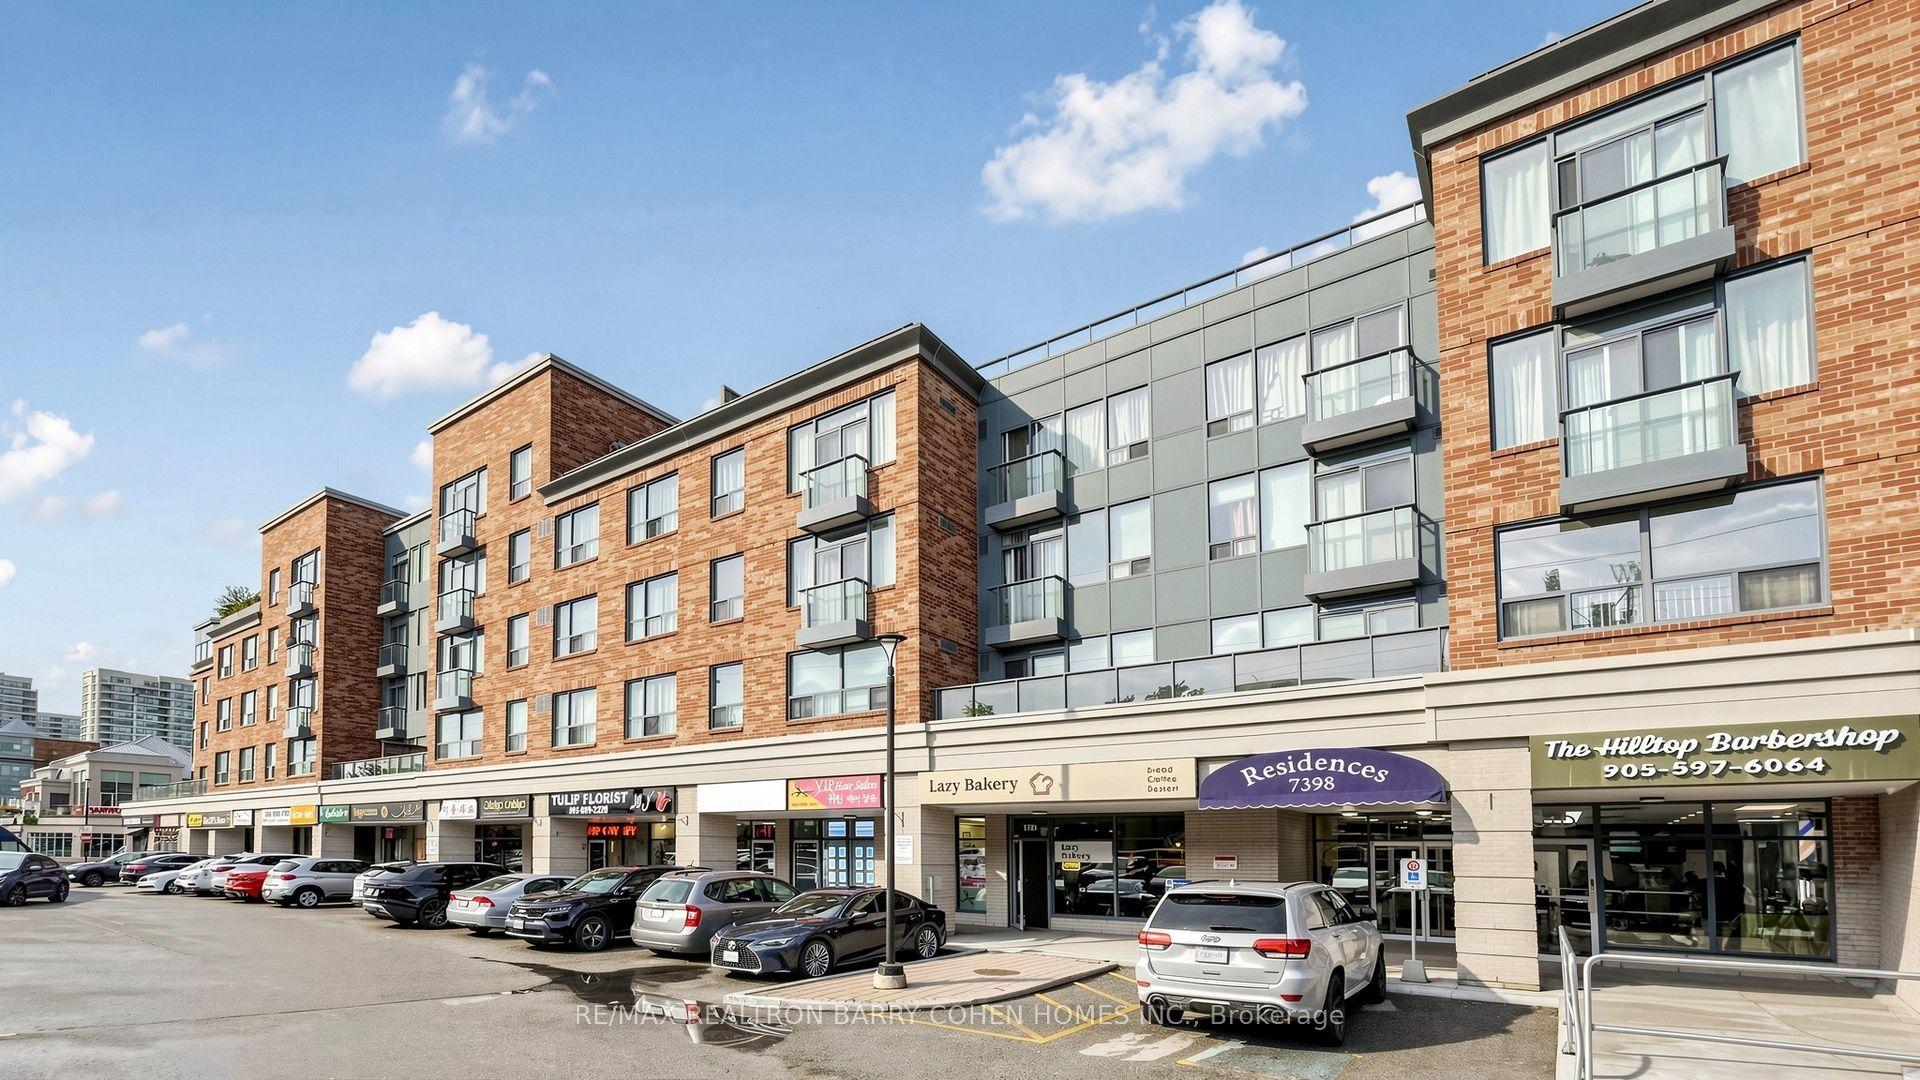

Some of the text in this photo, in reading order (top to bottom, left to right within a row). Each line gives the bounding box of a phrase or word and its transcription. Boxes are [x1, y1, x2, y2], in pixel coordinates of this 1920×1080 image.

[1544, 725, 1900, 759] The Hilltop Barbershop
[1240, 752, 1389, 787] Residences
[1603, 756, 1826, 778] 905-597-6064
[816, 779, 834, 790] VIP
[929, 777, 1018, 795] Lazy Bakery
[1288, 776, 1335, 793] 7398
[551, 794, 580, 806] TULIP
[582, 791, 629, 805] FLORIST
